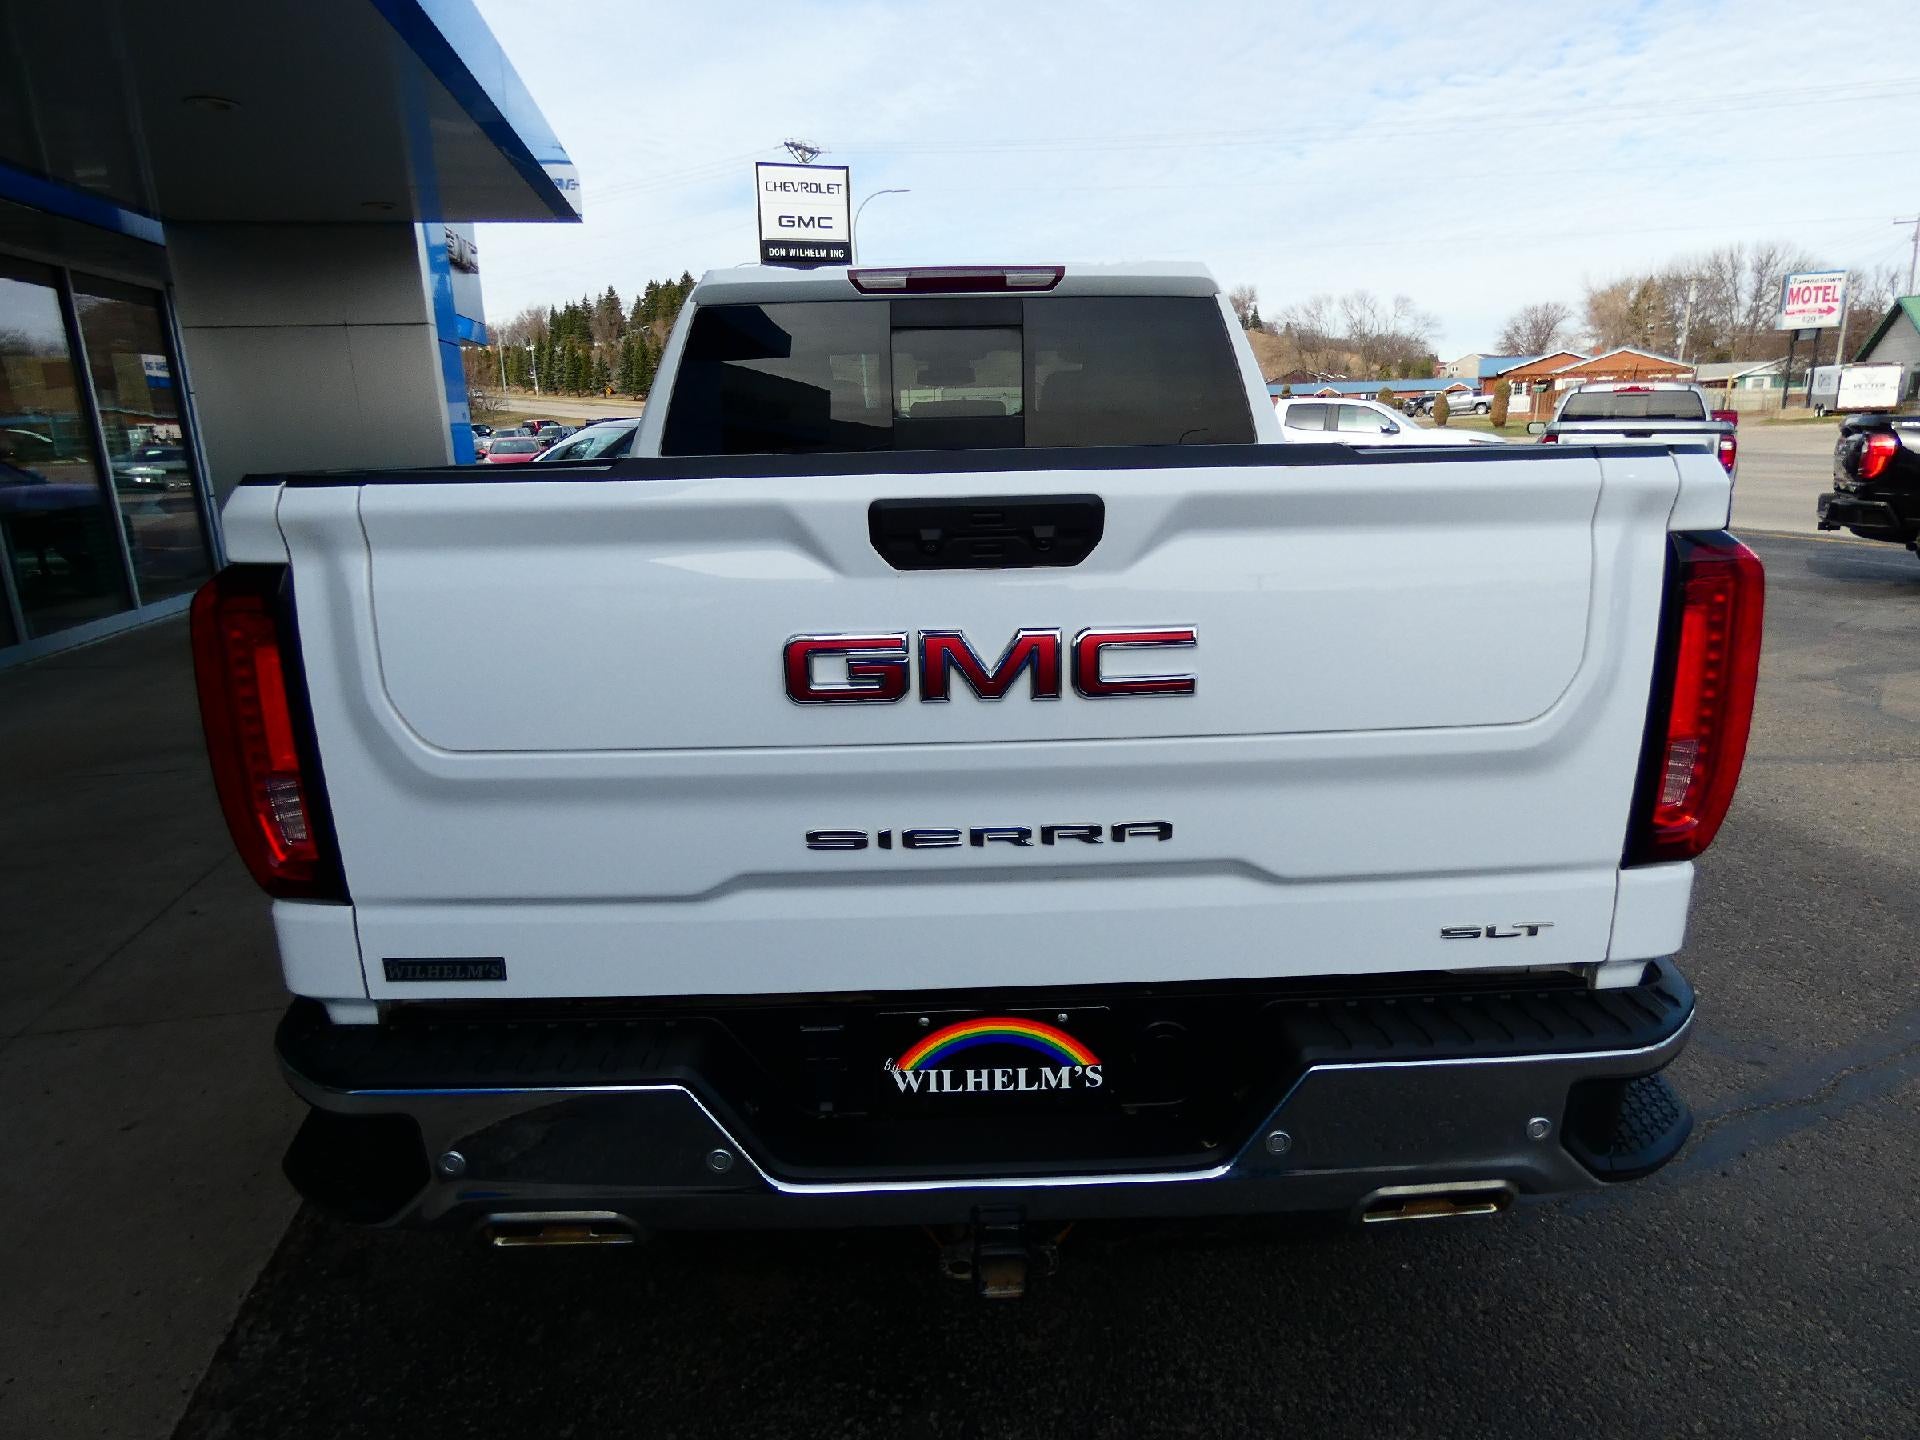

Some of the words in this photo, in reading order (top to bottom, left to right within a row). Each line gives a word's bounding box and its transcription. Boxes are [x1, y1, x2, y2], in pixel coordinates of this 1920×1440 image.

[765, 181, 842, 195] CHEVROLET
[778, 215, 833, 229] GMC
[769, 247, 786, 257] DON
[789, 248, 827, 258] WILHELM
[830, 248, 845, 258] INC
[1787, 285, 1840, 305] MOTEL
[783, 626, 1198, 706] GMC
[806, 820, 1173, 850] SIERRA
[1441, 921, 1555, 939] SLT
[386, 964, 501, 980] WILHELM'S
[892, 1064, 1103, 1093] WILHELM'S
